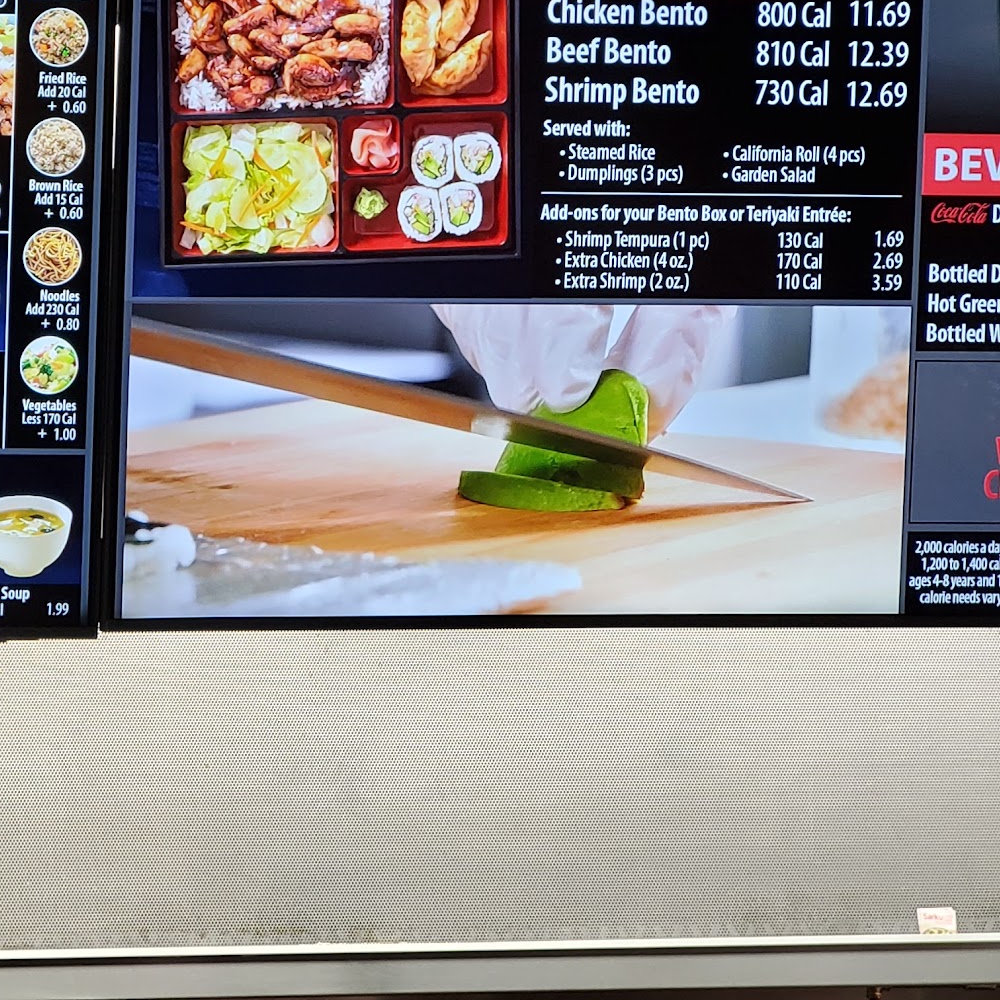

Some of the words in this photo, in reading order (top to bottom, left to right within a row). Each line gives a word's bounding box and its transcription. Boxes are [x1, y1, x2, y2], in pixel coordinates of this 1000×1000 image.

[640, 0, 707, 26] Bento
[758, 2, 796, 27] 800
[802, 2, 831, 27] Cal
[849, 1, 911, 27] 11.69
[546, 37, 600, 63] Beef
[604, 38, 671, 64] Bento
[756, 41, 795, 66] 810
[800, 41, 830, 67] Cal
[848, 41, 909, 67] 12.39
[39, 72, 64, 84] Fried
[66, 73, 86, 84] Rice
[38, 85, 56, 97] Add
[58, 85, 72, 98] 20
[74, 85, 86, 98] Cal
[545, 76, 627, 110] Shrimp
[632, 78, 699, 104] Bento
[755, 80, 794, 105] 730
[799, 80, 828, 105] Cal
[847, 81, 908, 107] 12.69
[63, 101, 86, 113] 0.60
[543, 120, 591, 137] Served
[594, 121, 631, 137] with:
[568, 144, 626, 161] Steamed
[629, 144, 655, 160] Rice
[733, 145, 792, 162] California
[796, 146, 820, 162] Roll
[732, 167, 777, 183] Garden
[780, 167, 815, 183] Salad
[541, 204, 598, 221] Add-ons
[601, 205, 621, 221] for
[623, 209, 655, 225] your
[658, 205, 698, 222] Bento
[701, 206, 727, 222] Box
[729, 210, 745, 222] or
[746, 206, 800, 226] Teriyaki
[803, 206, 851, 223] Entrée:
[565, 252, 597, 268] Extra
[600, 252, 649, 269] Chicken
[777, 253, 800, 269] 170
[803, 253, 822, 269] Cal
[873, 253, 903, 270] 2.69
[929, 264, 986, 283] Bottled
[928, 293, 956, 313] Hot
[915, 541, 942, 555] 2,000
[943, 541, 979, 554] calories
[1, 587, 30, 602] Soup
[46, 603, 68, 616] 1.99
